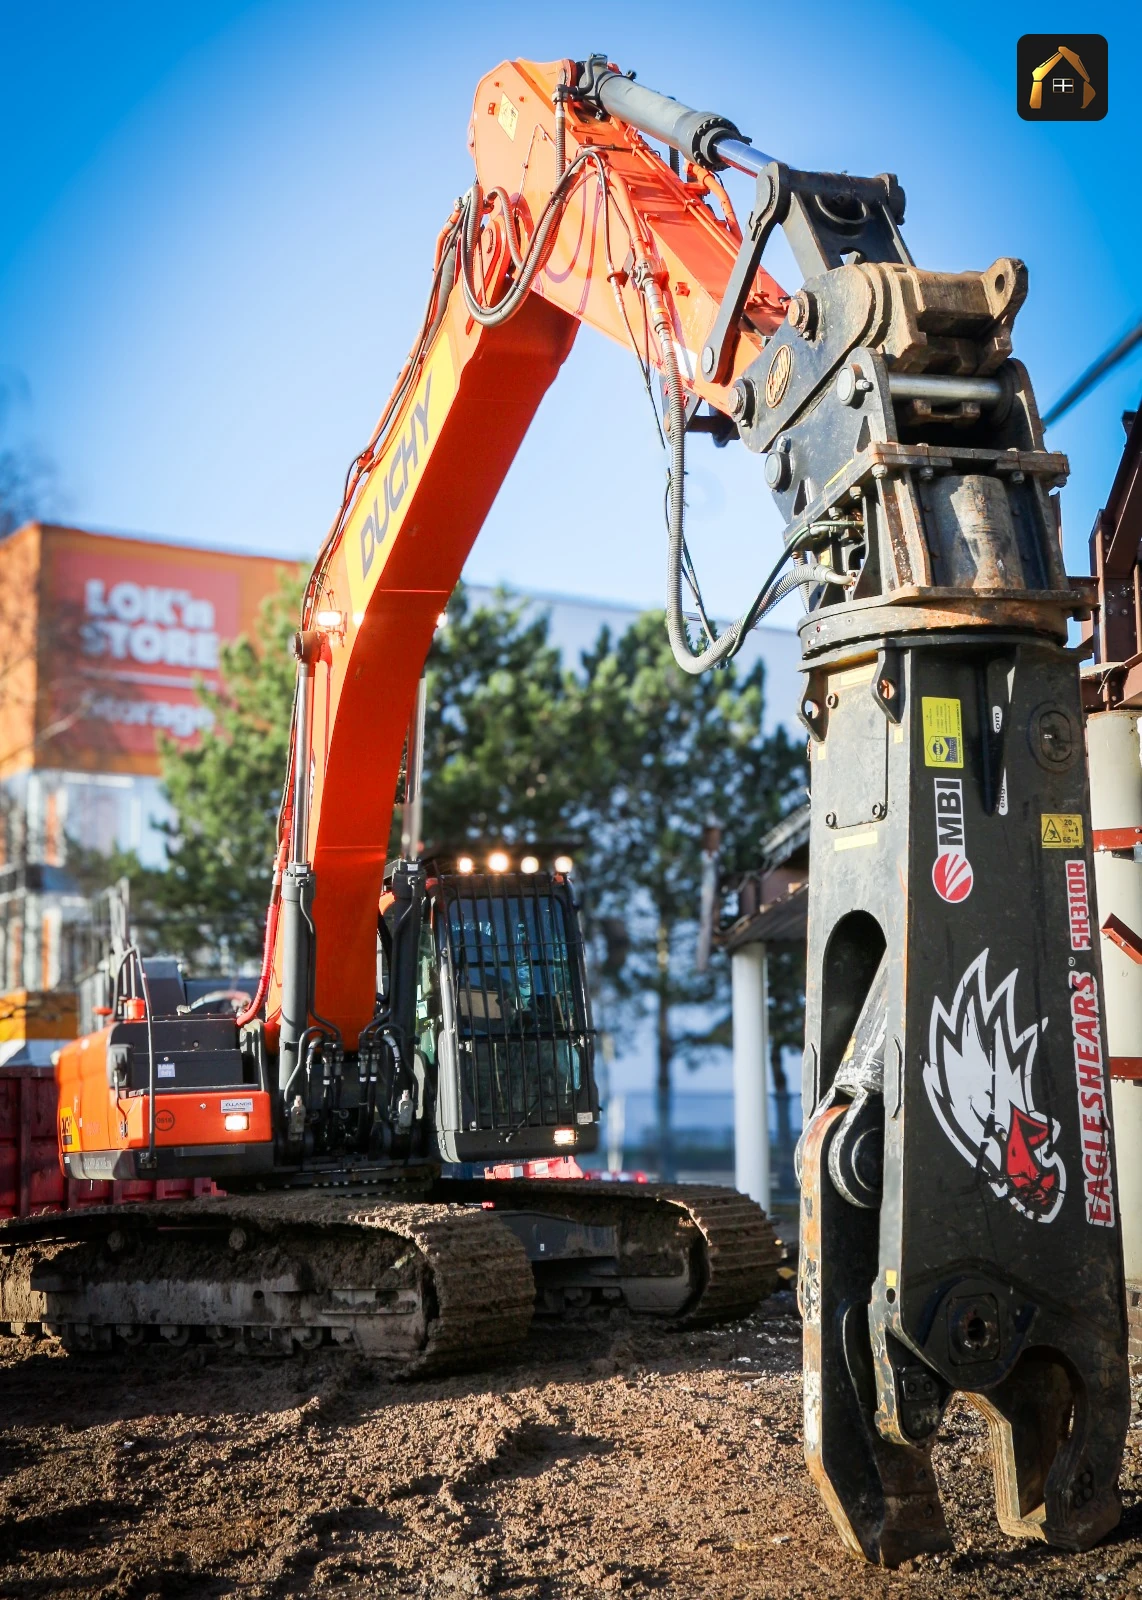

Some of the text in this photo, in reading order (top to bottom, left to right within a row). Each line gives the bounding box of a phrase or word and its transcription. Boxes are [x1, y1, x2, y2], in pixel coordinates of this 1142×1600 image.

[360, 368, 433, 582] DUCHY
[84, 579, 215, 630] LOK'n
[79, 620, 219, 669] STORE
[936, 780, 964, 846] MBI
[1067, 863, 1112, 1223] EAGLESHEARS SH310R
